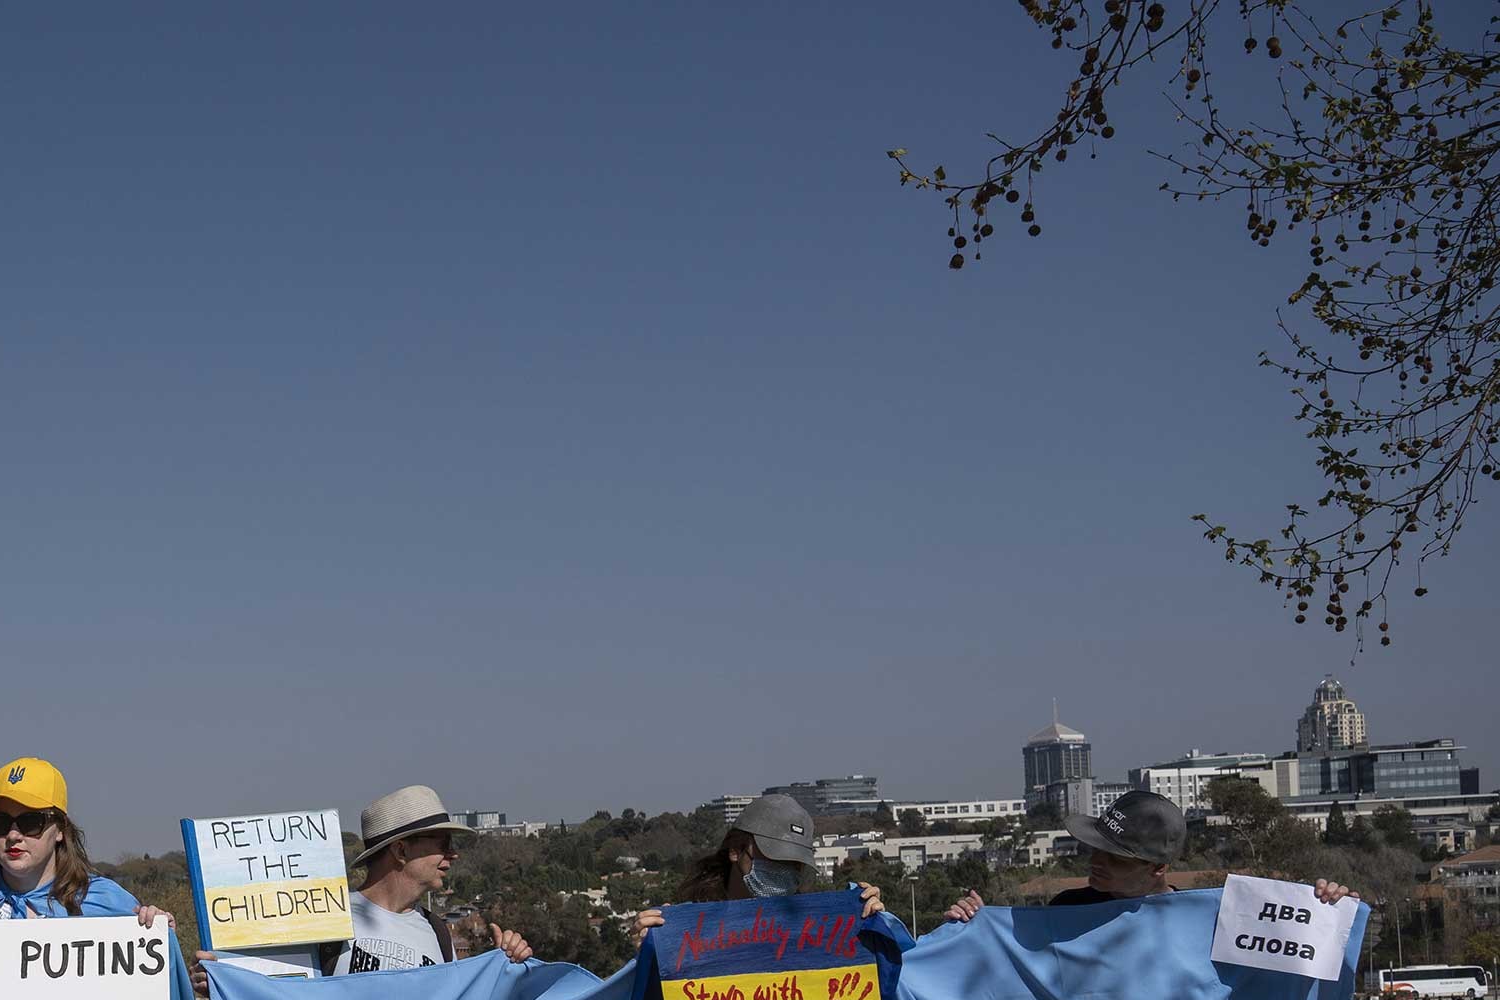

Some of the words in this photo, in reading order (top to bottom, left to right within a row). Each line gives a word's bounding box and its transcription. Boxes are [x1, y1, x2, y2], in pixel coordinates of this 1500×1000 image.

[211, 813, 328, 849] RETURN
[239, 853, 309, 881] THE
[211, 886, 347, 923] CHILDREN
[1258, 902, 1312, 925] два
[20, 937, 166, 979] PUTIN'S
[1235, 932, 1316, 961] слова
